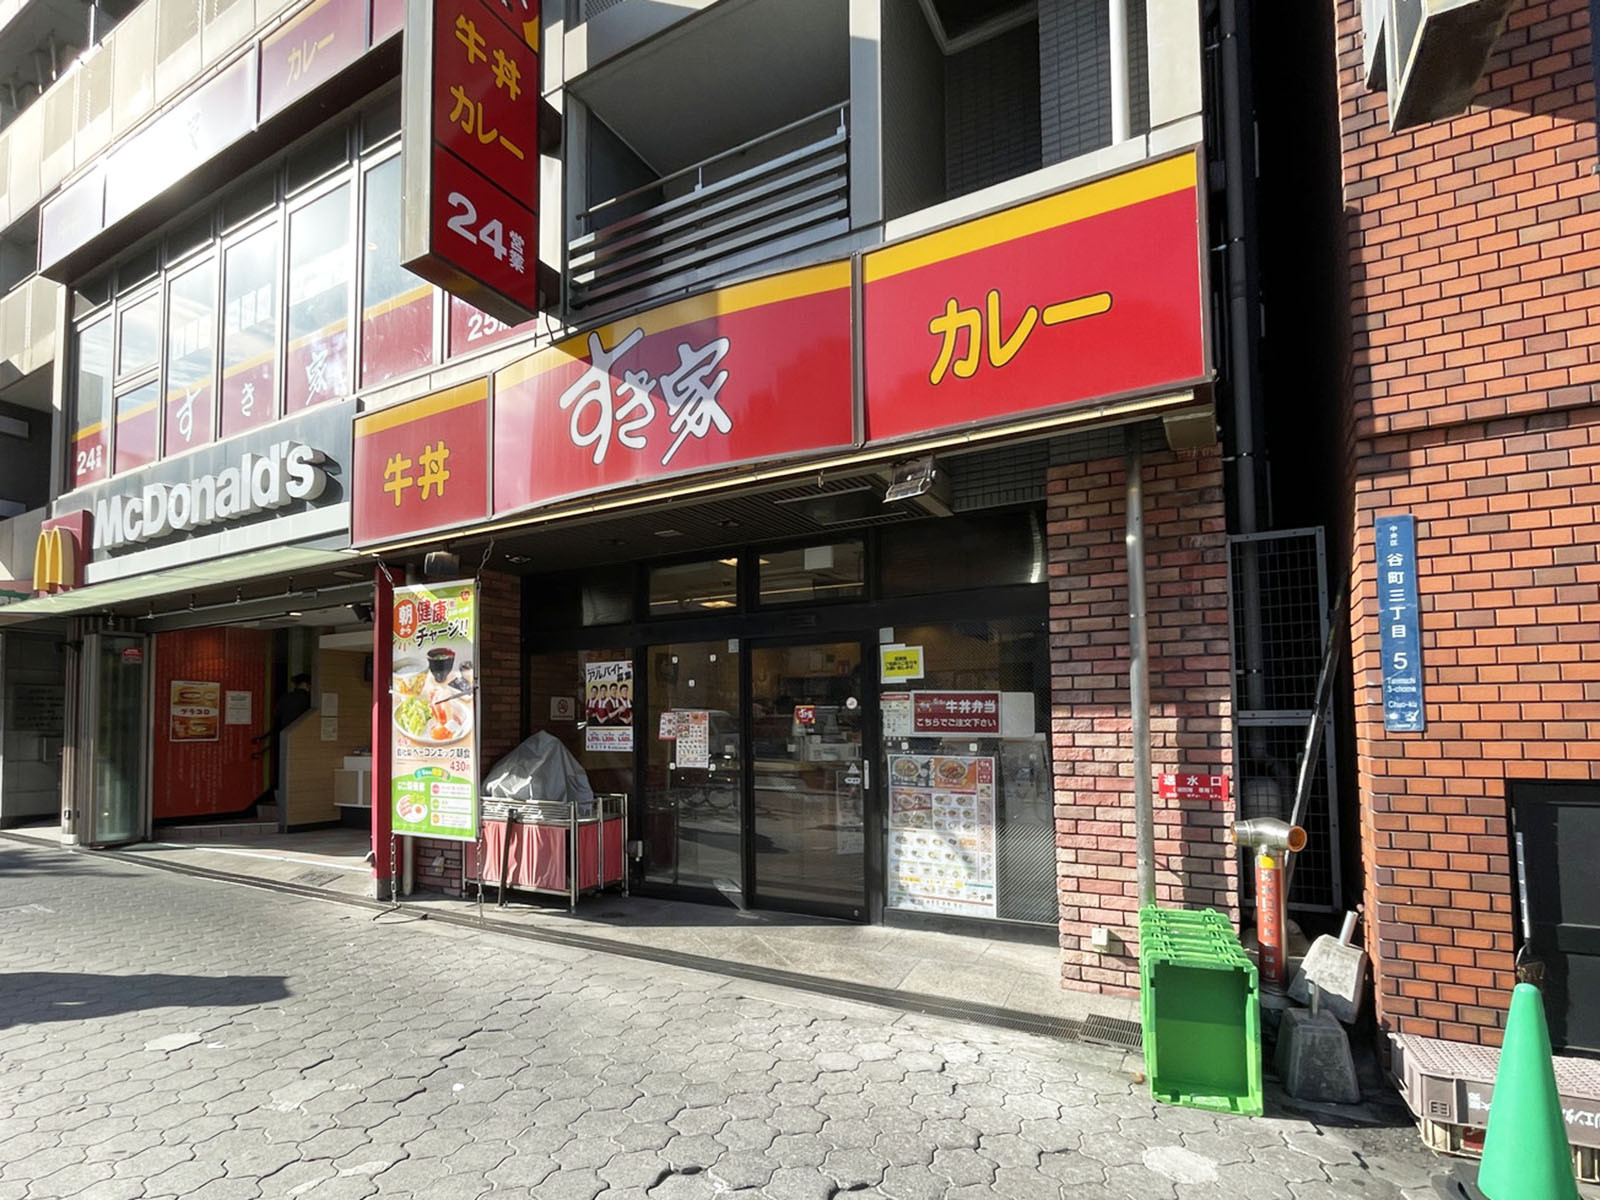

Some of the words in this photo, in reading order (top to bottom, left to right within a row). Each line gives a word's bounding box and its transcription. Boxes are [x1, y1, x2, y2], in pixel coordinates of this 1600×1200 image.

[455, 14, 522, 101] 牛丼
[449, 85, 524, 160] カレー
[447, 191, 508, 261] 24
[928, 289, 1113, 385] カレー
[559, 327, 733, 467] すき家
[93, 440, 322, 549] McDonald's
[383, 441, 451, 507] 牛丼
[417, 600, 447, 624] 健康
[1387, 553, 1407, 638] 谷町三丁目
[1393, 653, 1408, 670] 5
[945, 699, 996, 714] 牛丼弁当
[1163, 775, 1222, 787] 送水口
